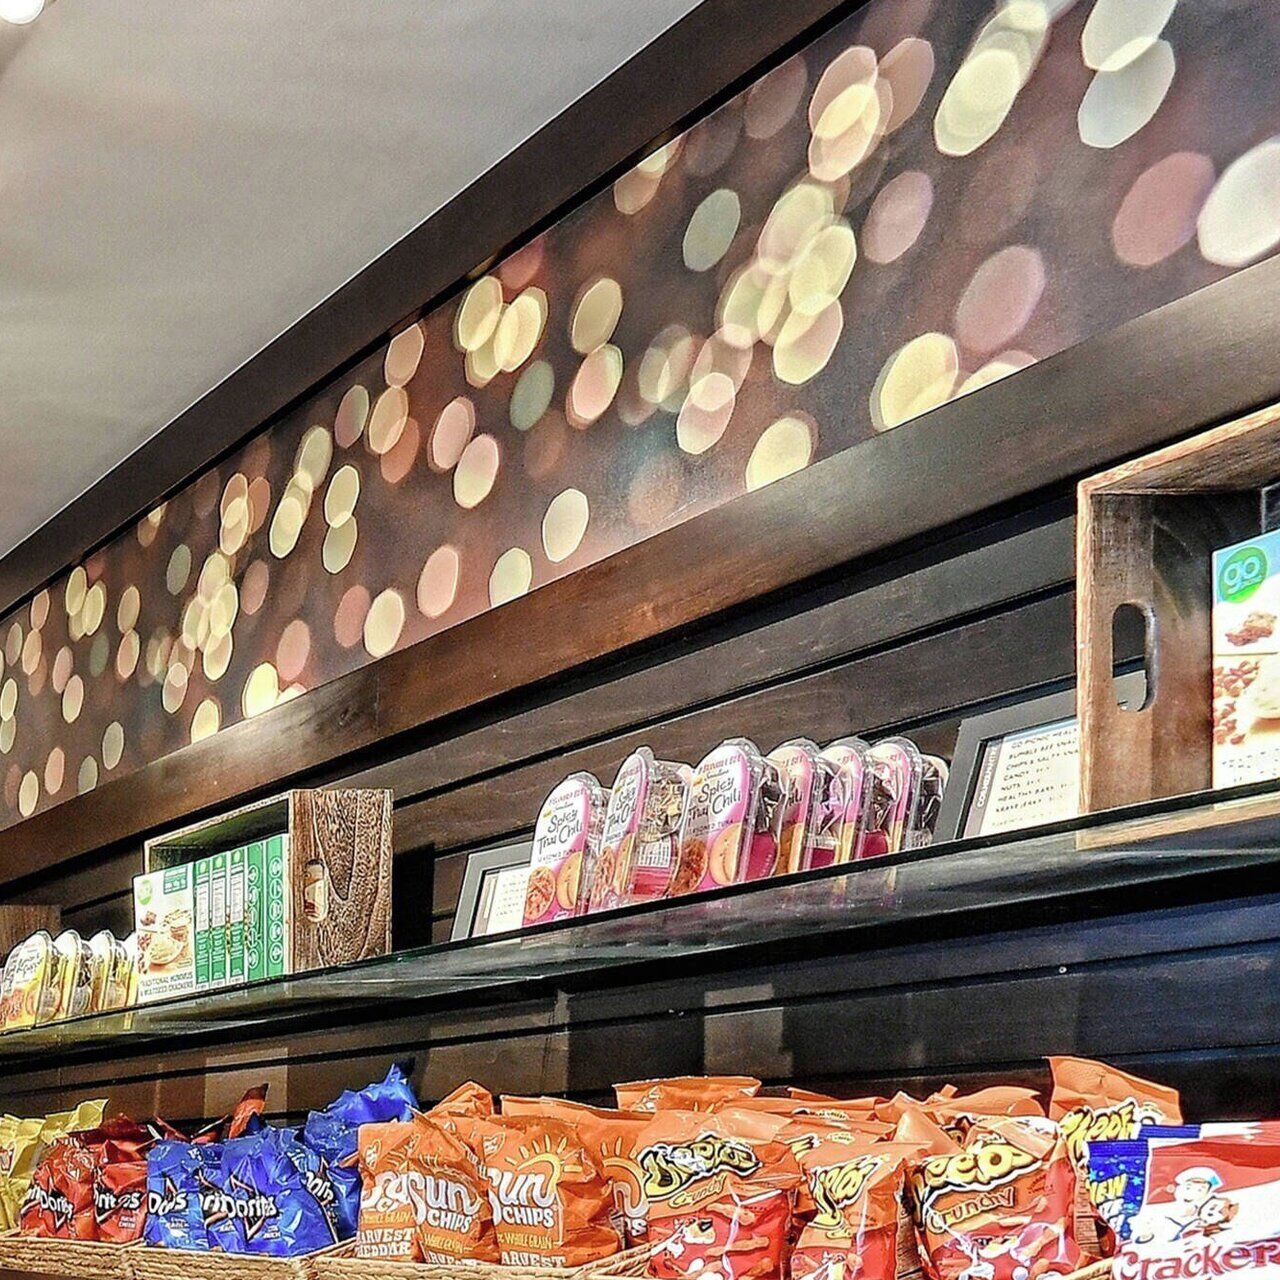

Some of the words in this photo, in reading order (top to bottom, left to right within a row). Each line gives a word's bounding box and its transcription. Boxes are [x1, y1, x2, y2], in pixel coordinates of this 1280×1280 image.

[1223, 555, 1260, 595] go
[698, 778, 735, 807] Spicy
[547, 808, 579, 834] Spicy
[408, 1170, 484, 1225] Sun
[487, 1166, 560, 1226] Sun
[928, 1185, 1016, 1234] Crunchy
[427, 1208, 473, 1233] CHIPS
[502, 1206, 556, 1229] CHIPS
